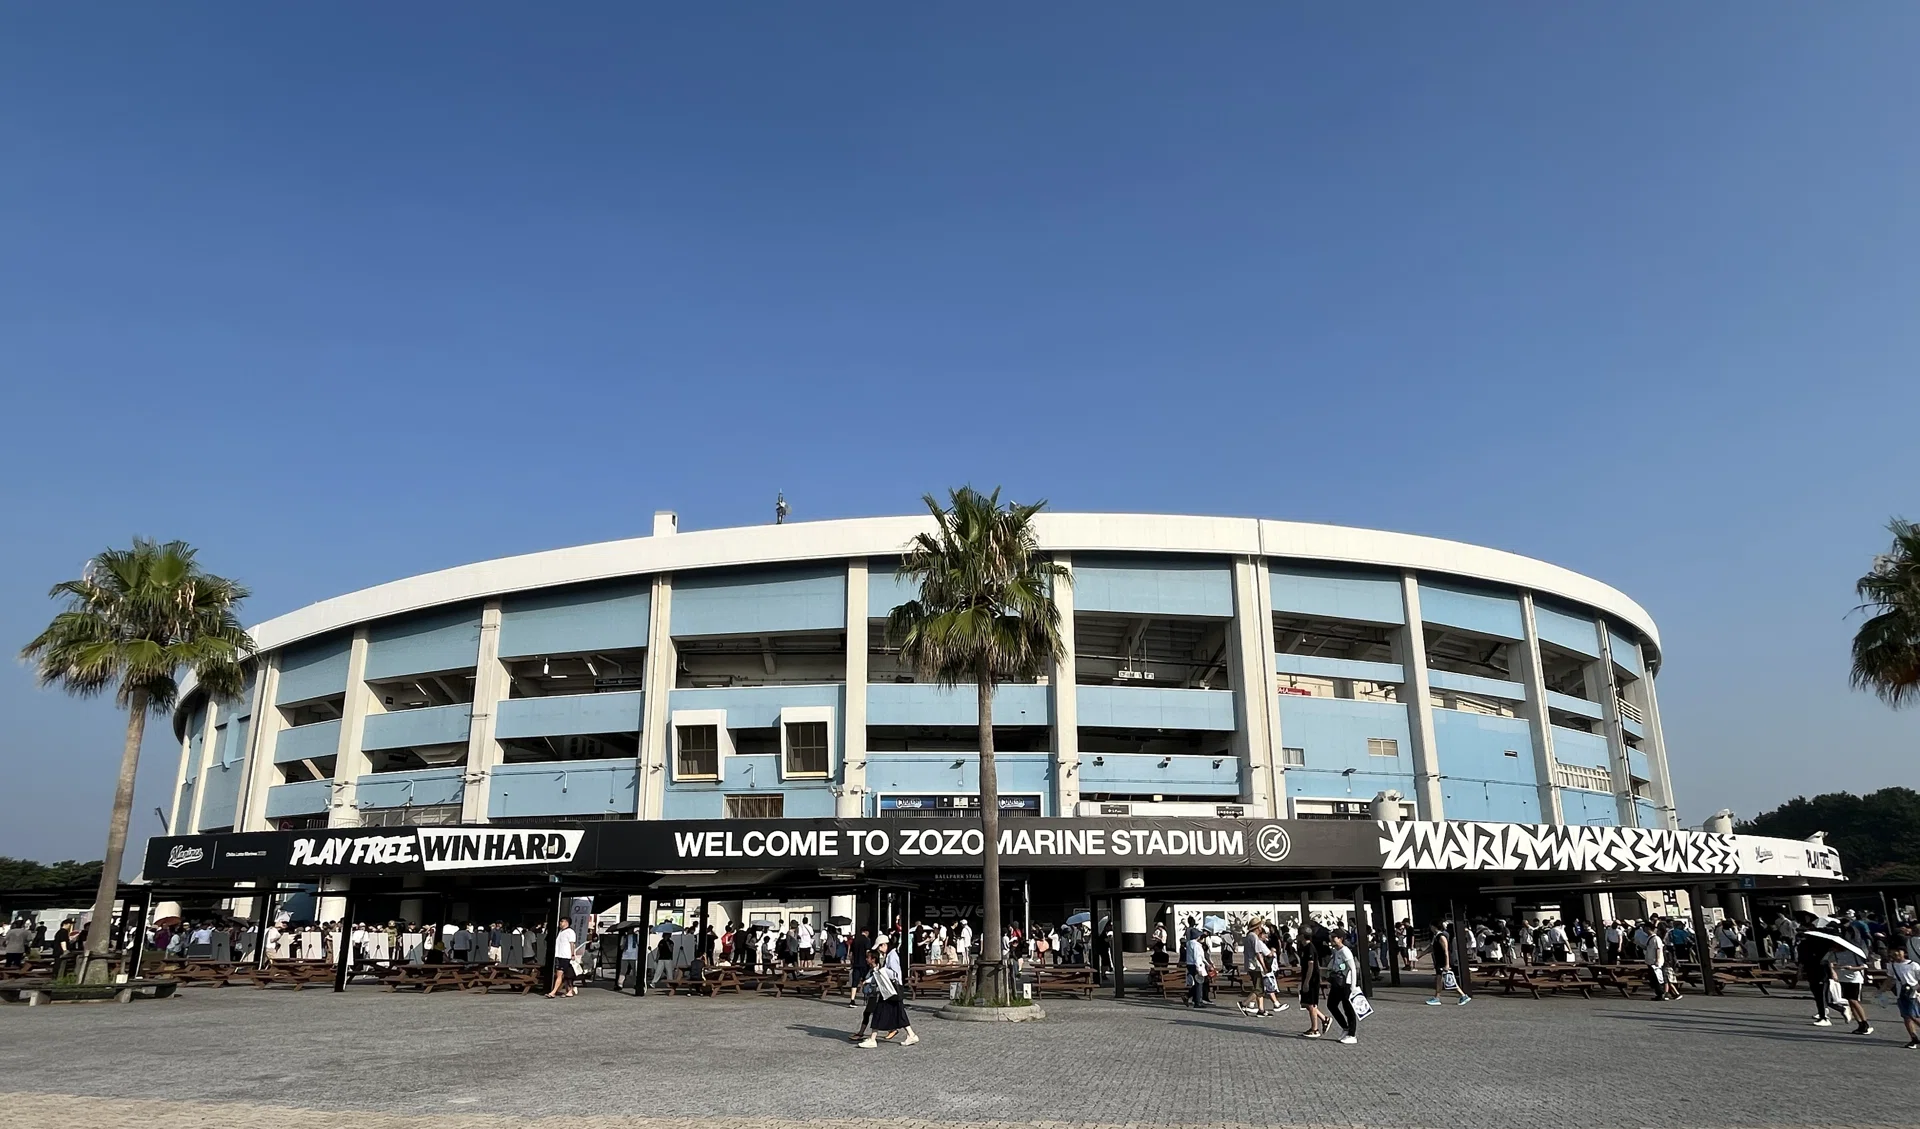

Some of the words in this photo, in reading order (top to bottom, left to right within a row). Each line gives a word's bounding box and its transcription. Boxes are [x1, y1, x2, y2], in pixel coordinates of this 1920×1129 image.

[289, 838, 351, 866] PLAY
[350, 834, 419, 864] FREE.
[423, 833, 485, 862] WIN
[485, 832, 572, 861] HARD.
[674, 830, 838, 857] WELCOME
[846, 829, 890, 856] TO
[899, 828, 984, 856] ZOZO
[1111, 829, 1244, 856] STADIUM
